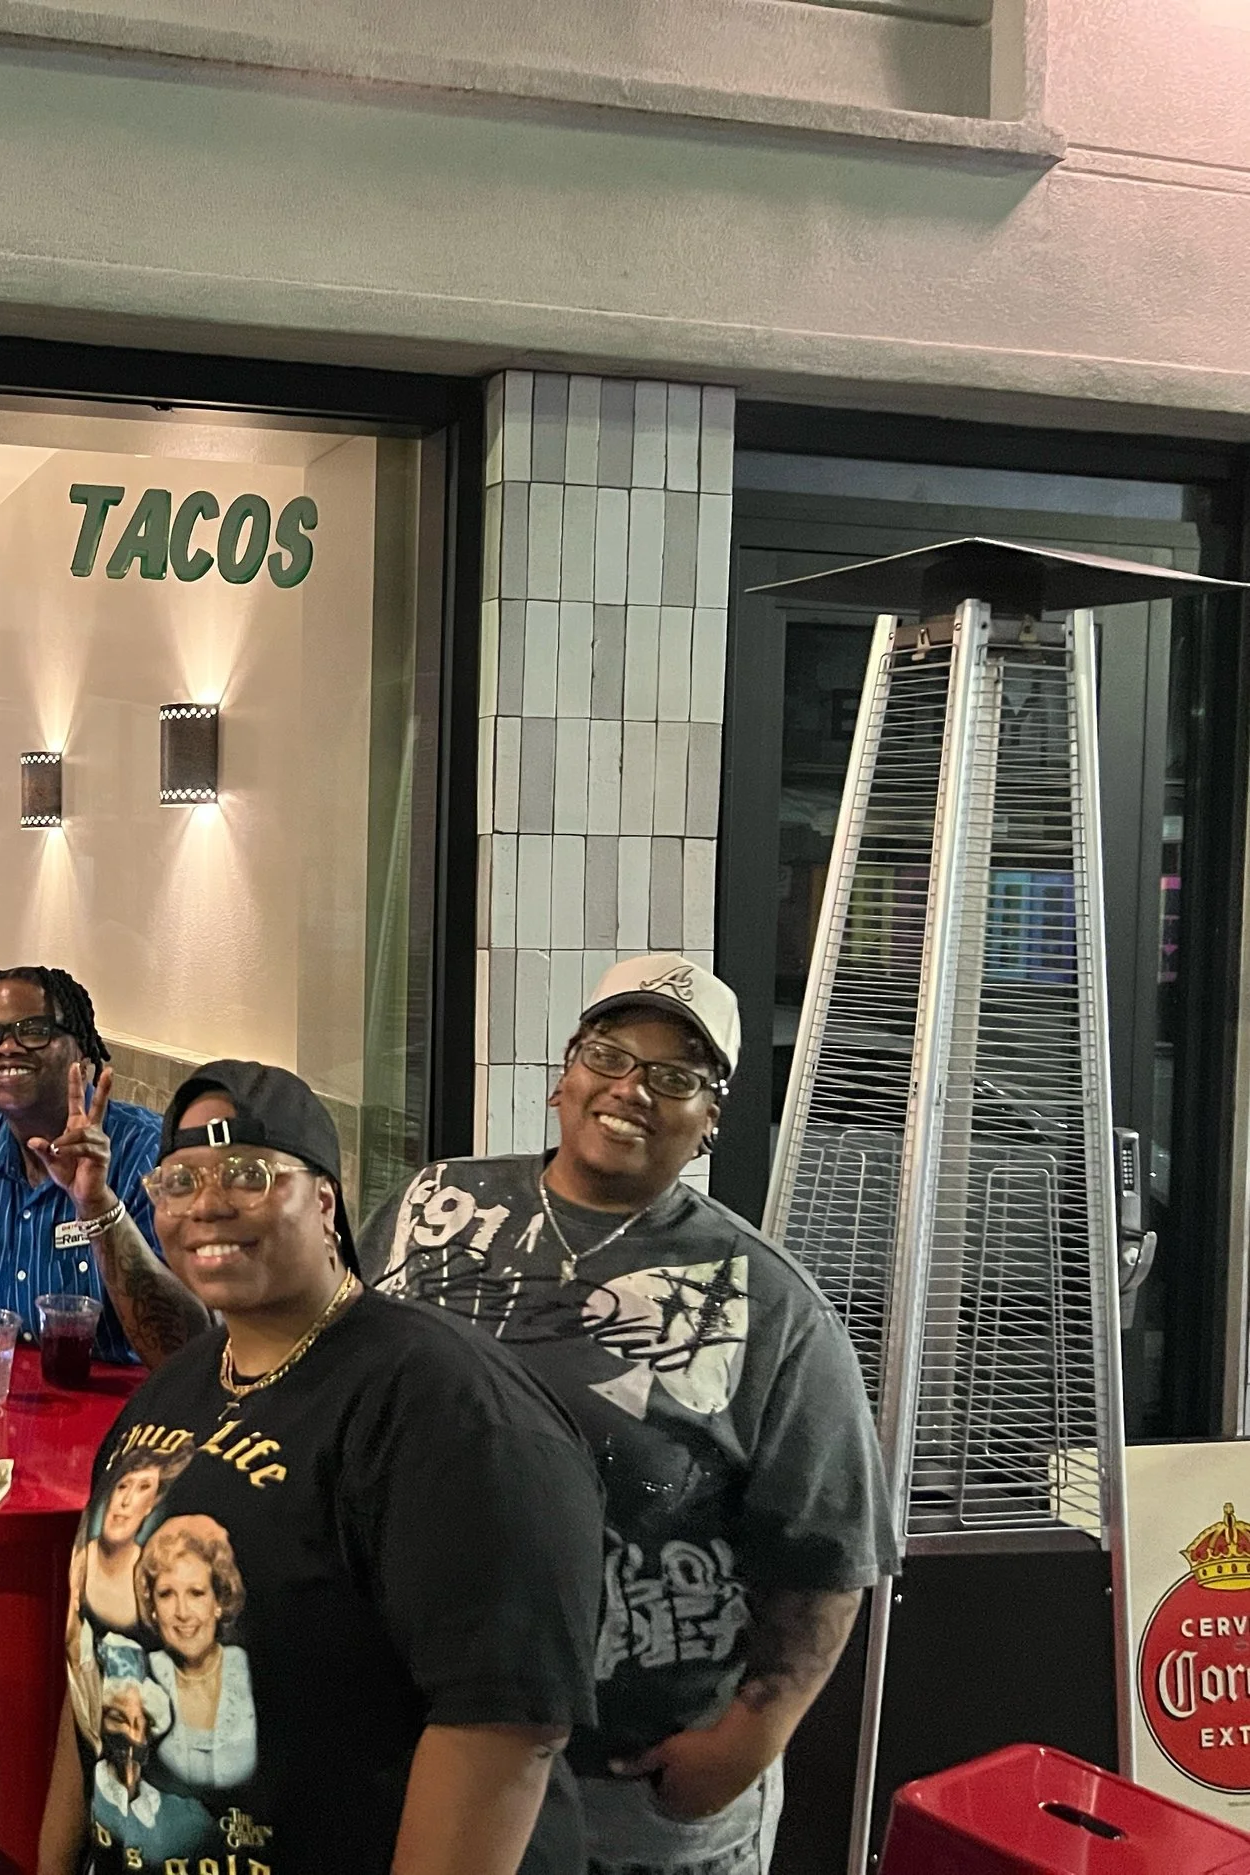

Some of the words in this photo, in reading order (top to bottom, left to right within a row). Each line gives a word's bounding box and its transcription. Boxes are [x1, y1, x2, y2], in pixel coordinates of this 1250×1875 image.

[69, 484, 318, 588] TACOS
[197, 1420, 287, 1488] Life
[1181, 1616, 1250, 1637] CERV
[1159, 1649, 1250, 1718] Cor
